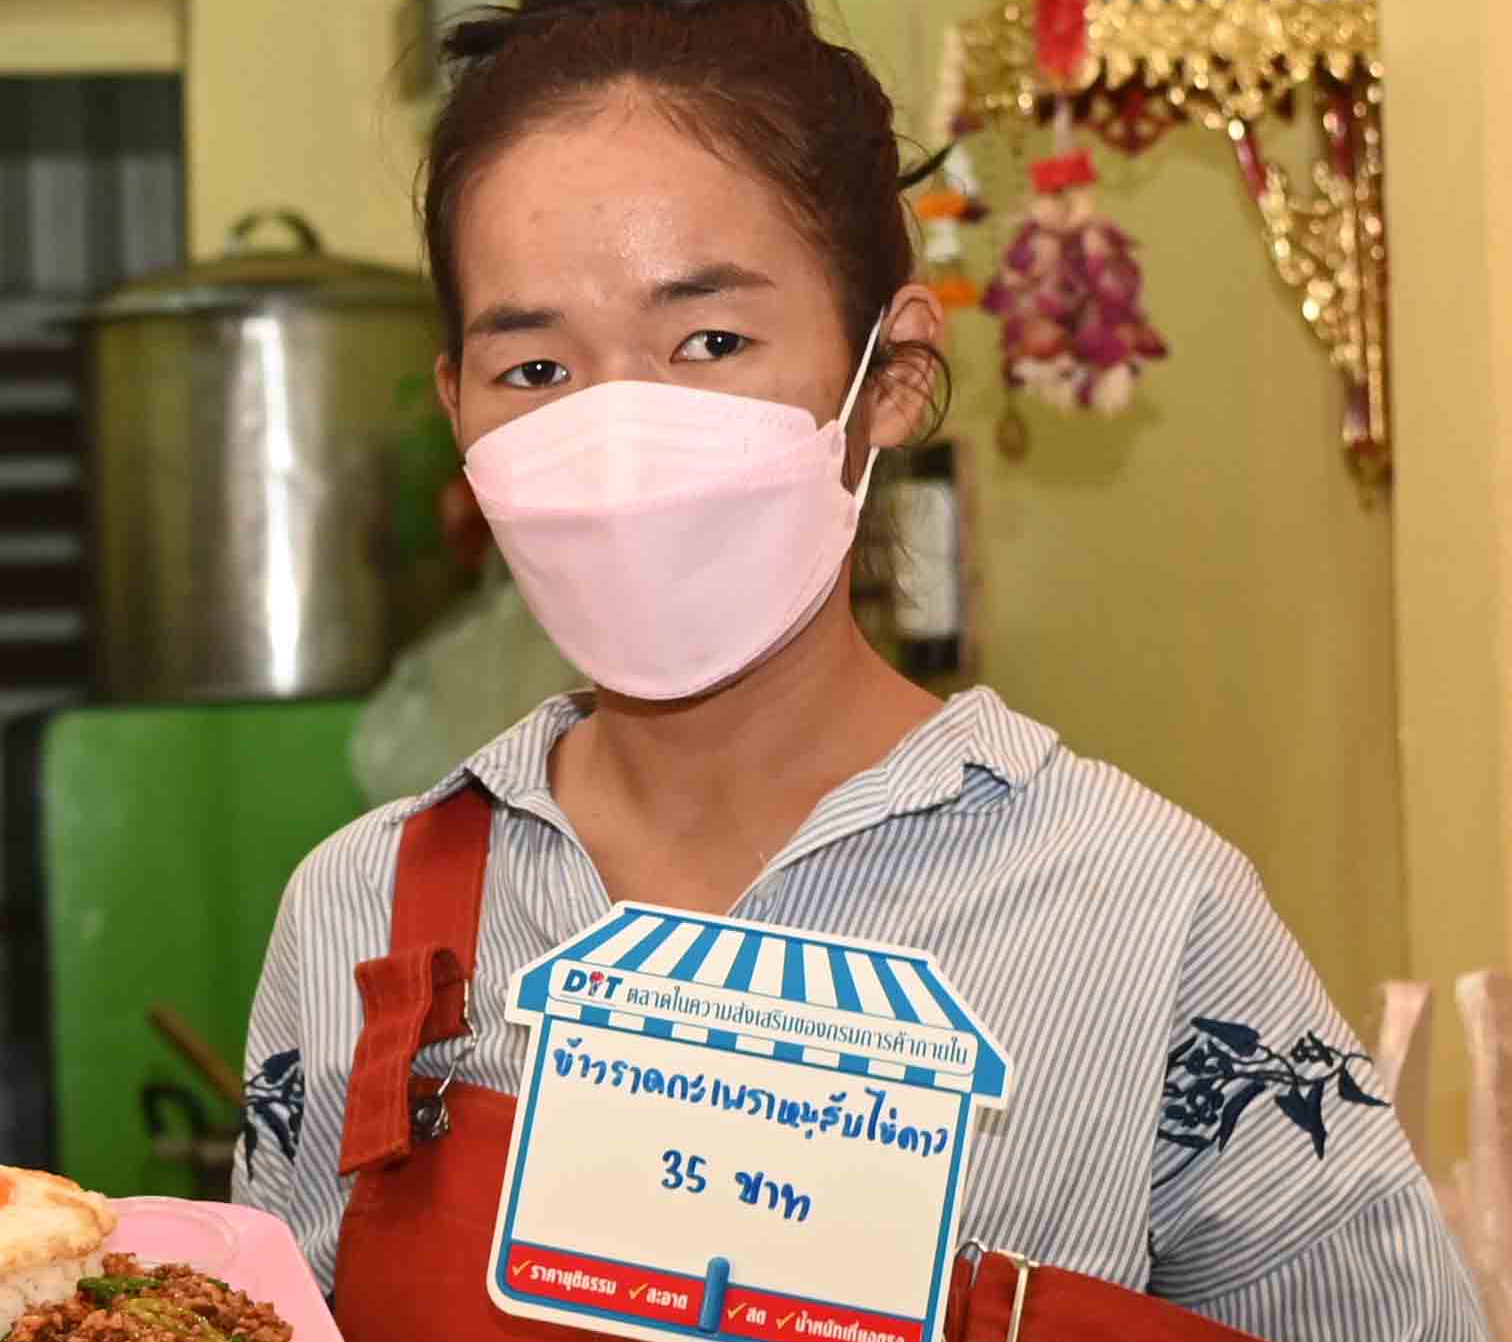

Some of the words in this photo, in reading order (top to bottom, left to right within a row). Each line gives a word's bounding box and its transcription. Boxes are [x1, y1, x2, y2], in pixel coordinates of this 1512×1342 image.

[562, 969, 624, 1000] DIT
[626, 985, 968, 1065] ตลาดในความส่งเสริมของกรมการค้าภายใน
[661, 1148, 707, 1194] 35
[529, 1264, 617, 1295] ราคายุติธรรม
[645, 1287, 688, 1310] สะอาด
[745, 1306, 767, 1326] สด
